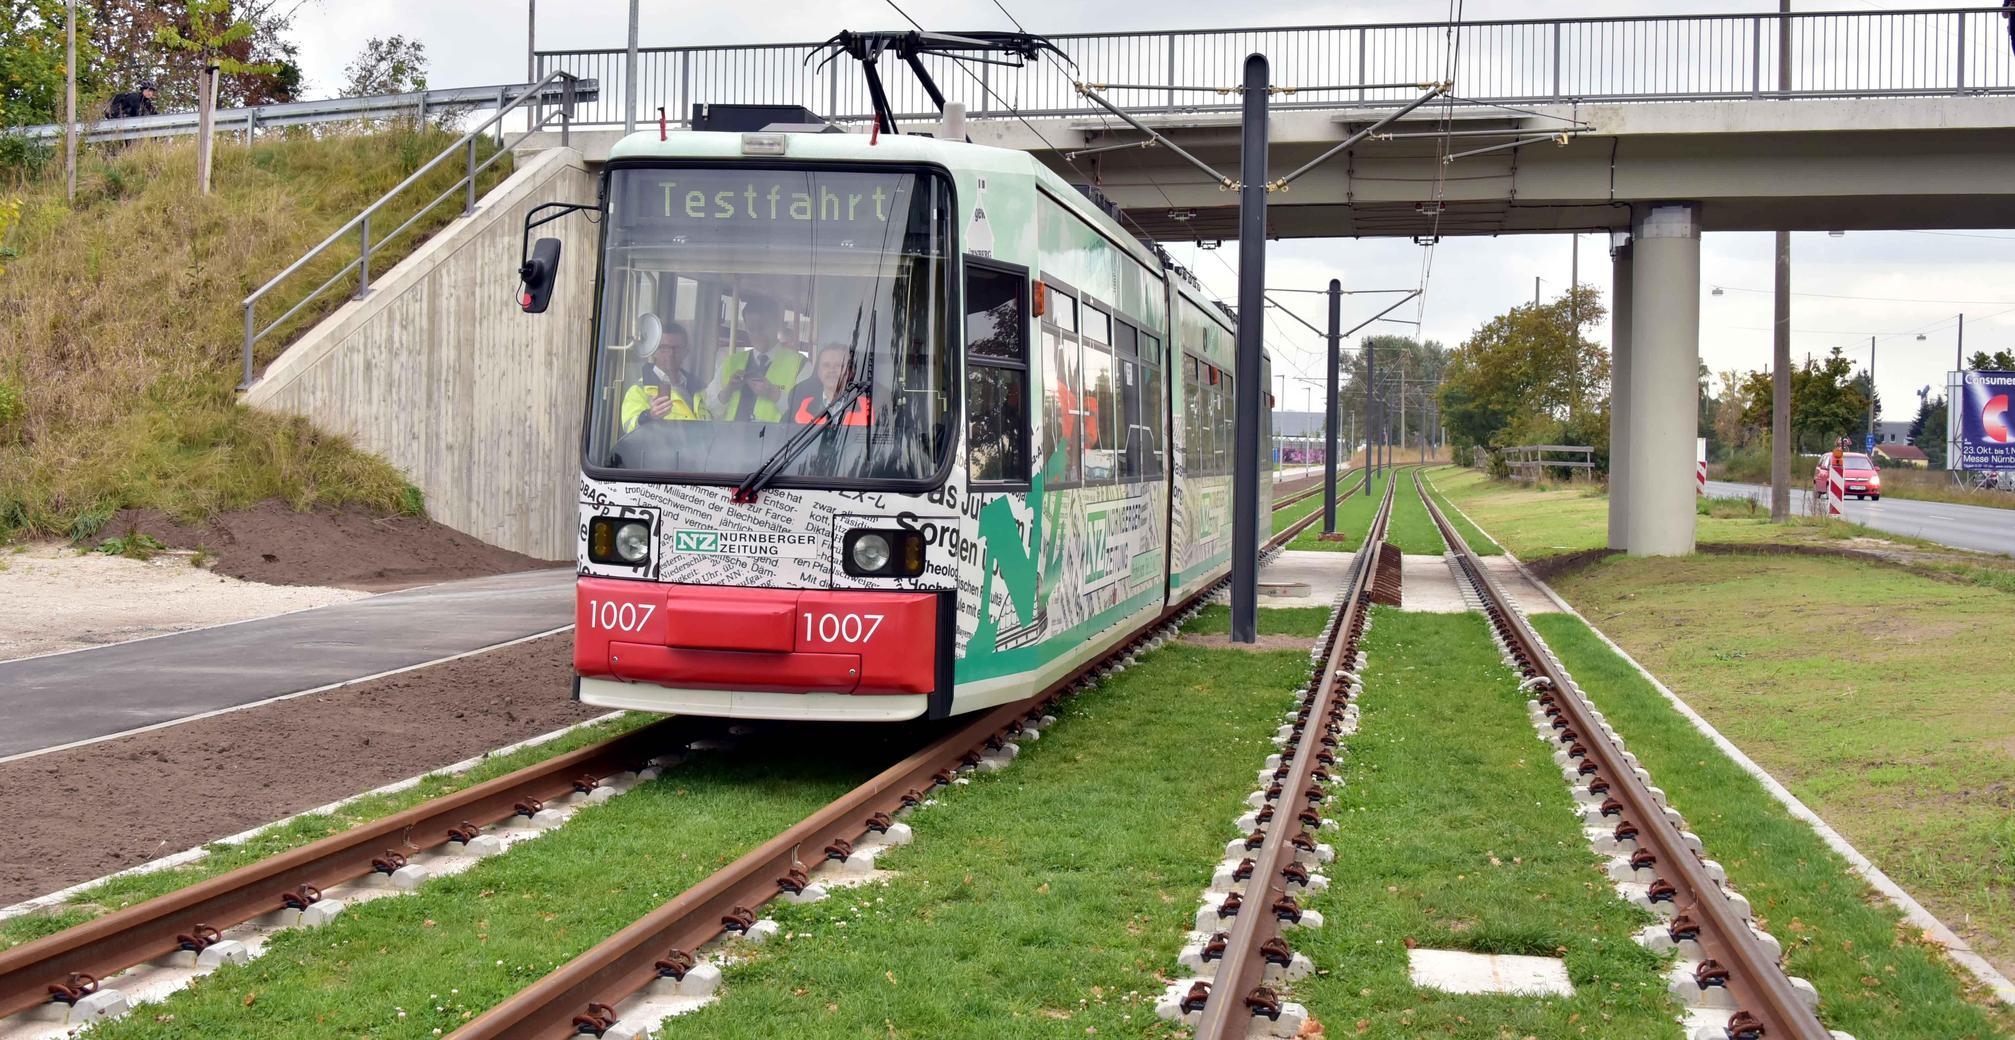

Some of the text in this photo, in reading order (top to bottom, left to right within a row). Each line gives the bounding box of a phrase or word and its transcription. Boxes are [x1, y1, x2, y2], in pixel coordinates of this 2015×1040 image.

[658, 181, 887, 222] Testfahrt
[1963, 446, 1975, 455] 23.
[1963, 455, 2015, 464] Messe Nürnb
[664, 485, 705, 507] Milliarden
[708, 501, 724, 513] der
[763, 495, 798, 514] Entsor-
[787, 491, 802, 505] hat
[663, 508, 680, 522] und
[747, 503, 762, 514] zur
[677, 532, 716, 550] NZ
[719, 531, 816, 545] NÜRNBERGER
[719, 543, 778, 555] ZEITUNG
[751, 562, 777, 577] Däm-
[590, 600, 657, 633] 1007
[803, 612, 886, 644] 1007
